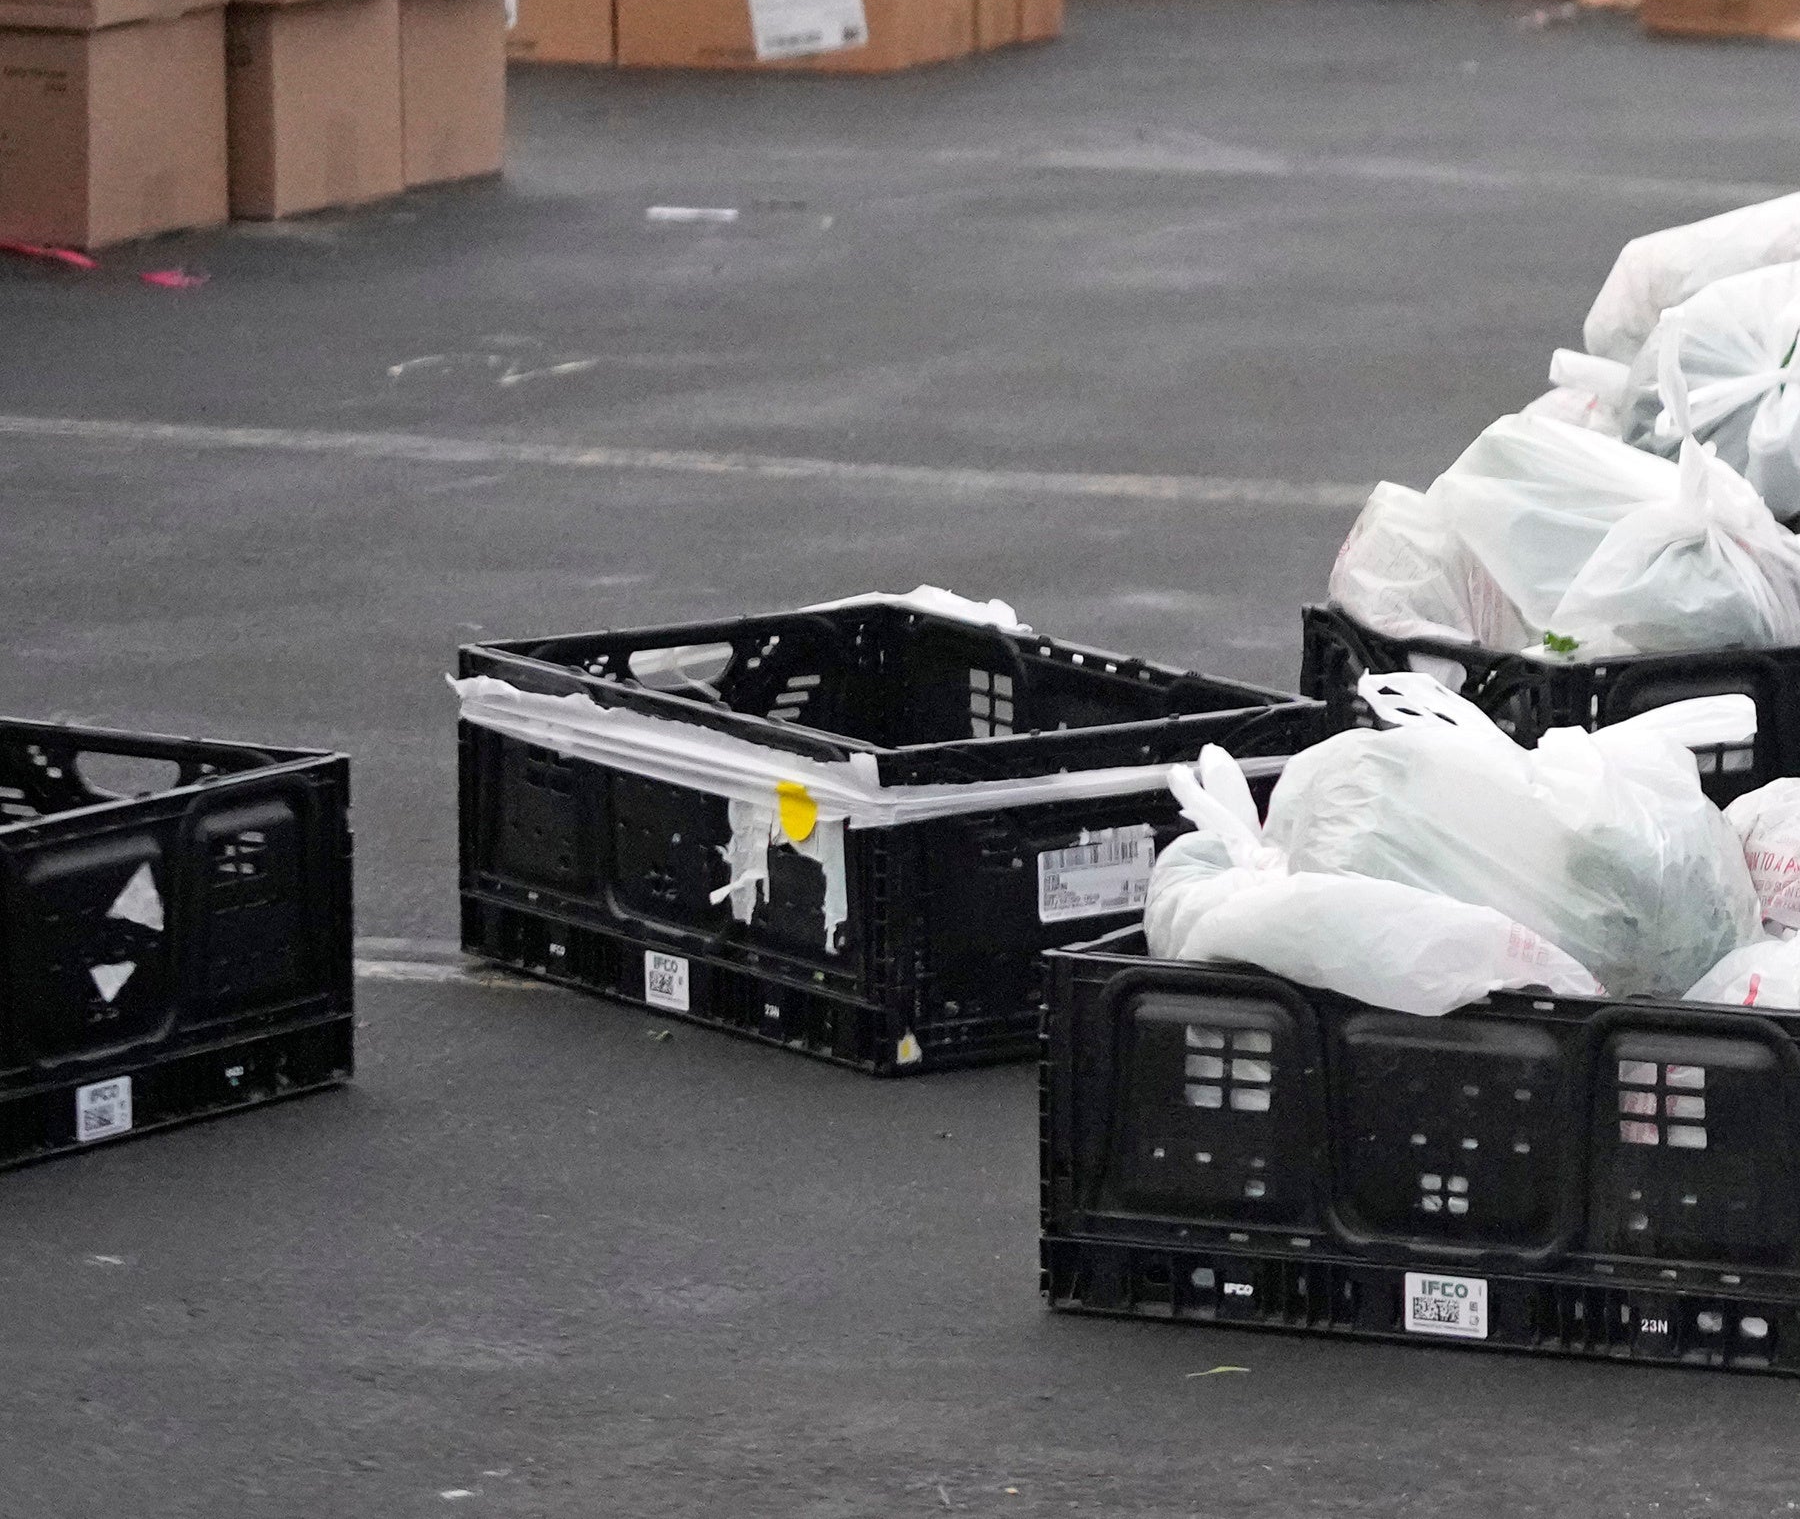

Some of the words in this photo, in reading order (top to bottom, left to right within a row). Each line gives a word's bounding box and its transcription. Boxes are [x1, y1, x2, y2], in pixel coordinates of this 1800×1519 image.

[1759, 852, 1775, 870] TO
[1773, 854, 1783, 871] A
[1421, 1279, 1469, 1299] IFCO
[1640, 1318, 1668, 1334] 23N
